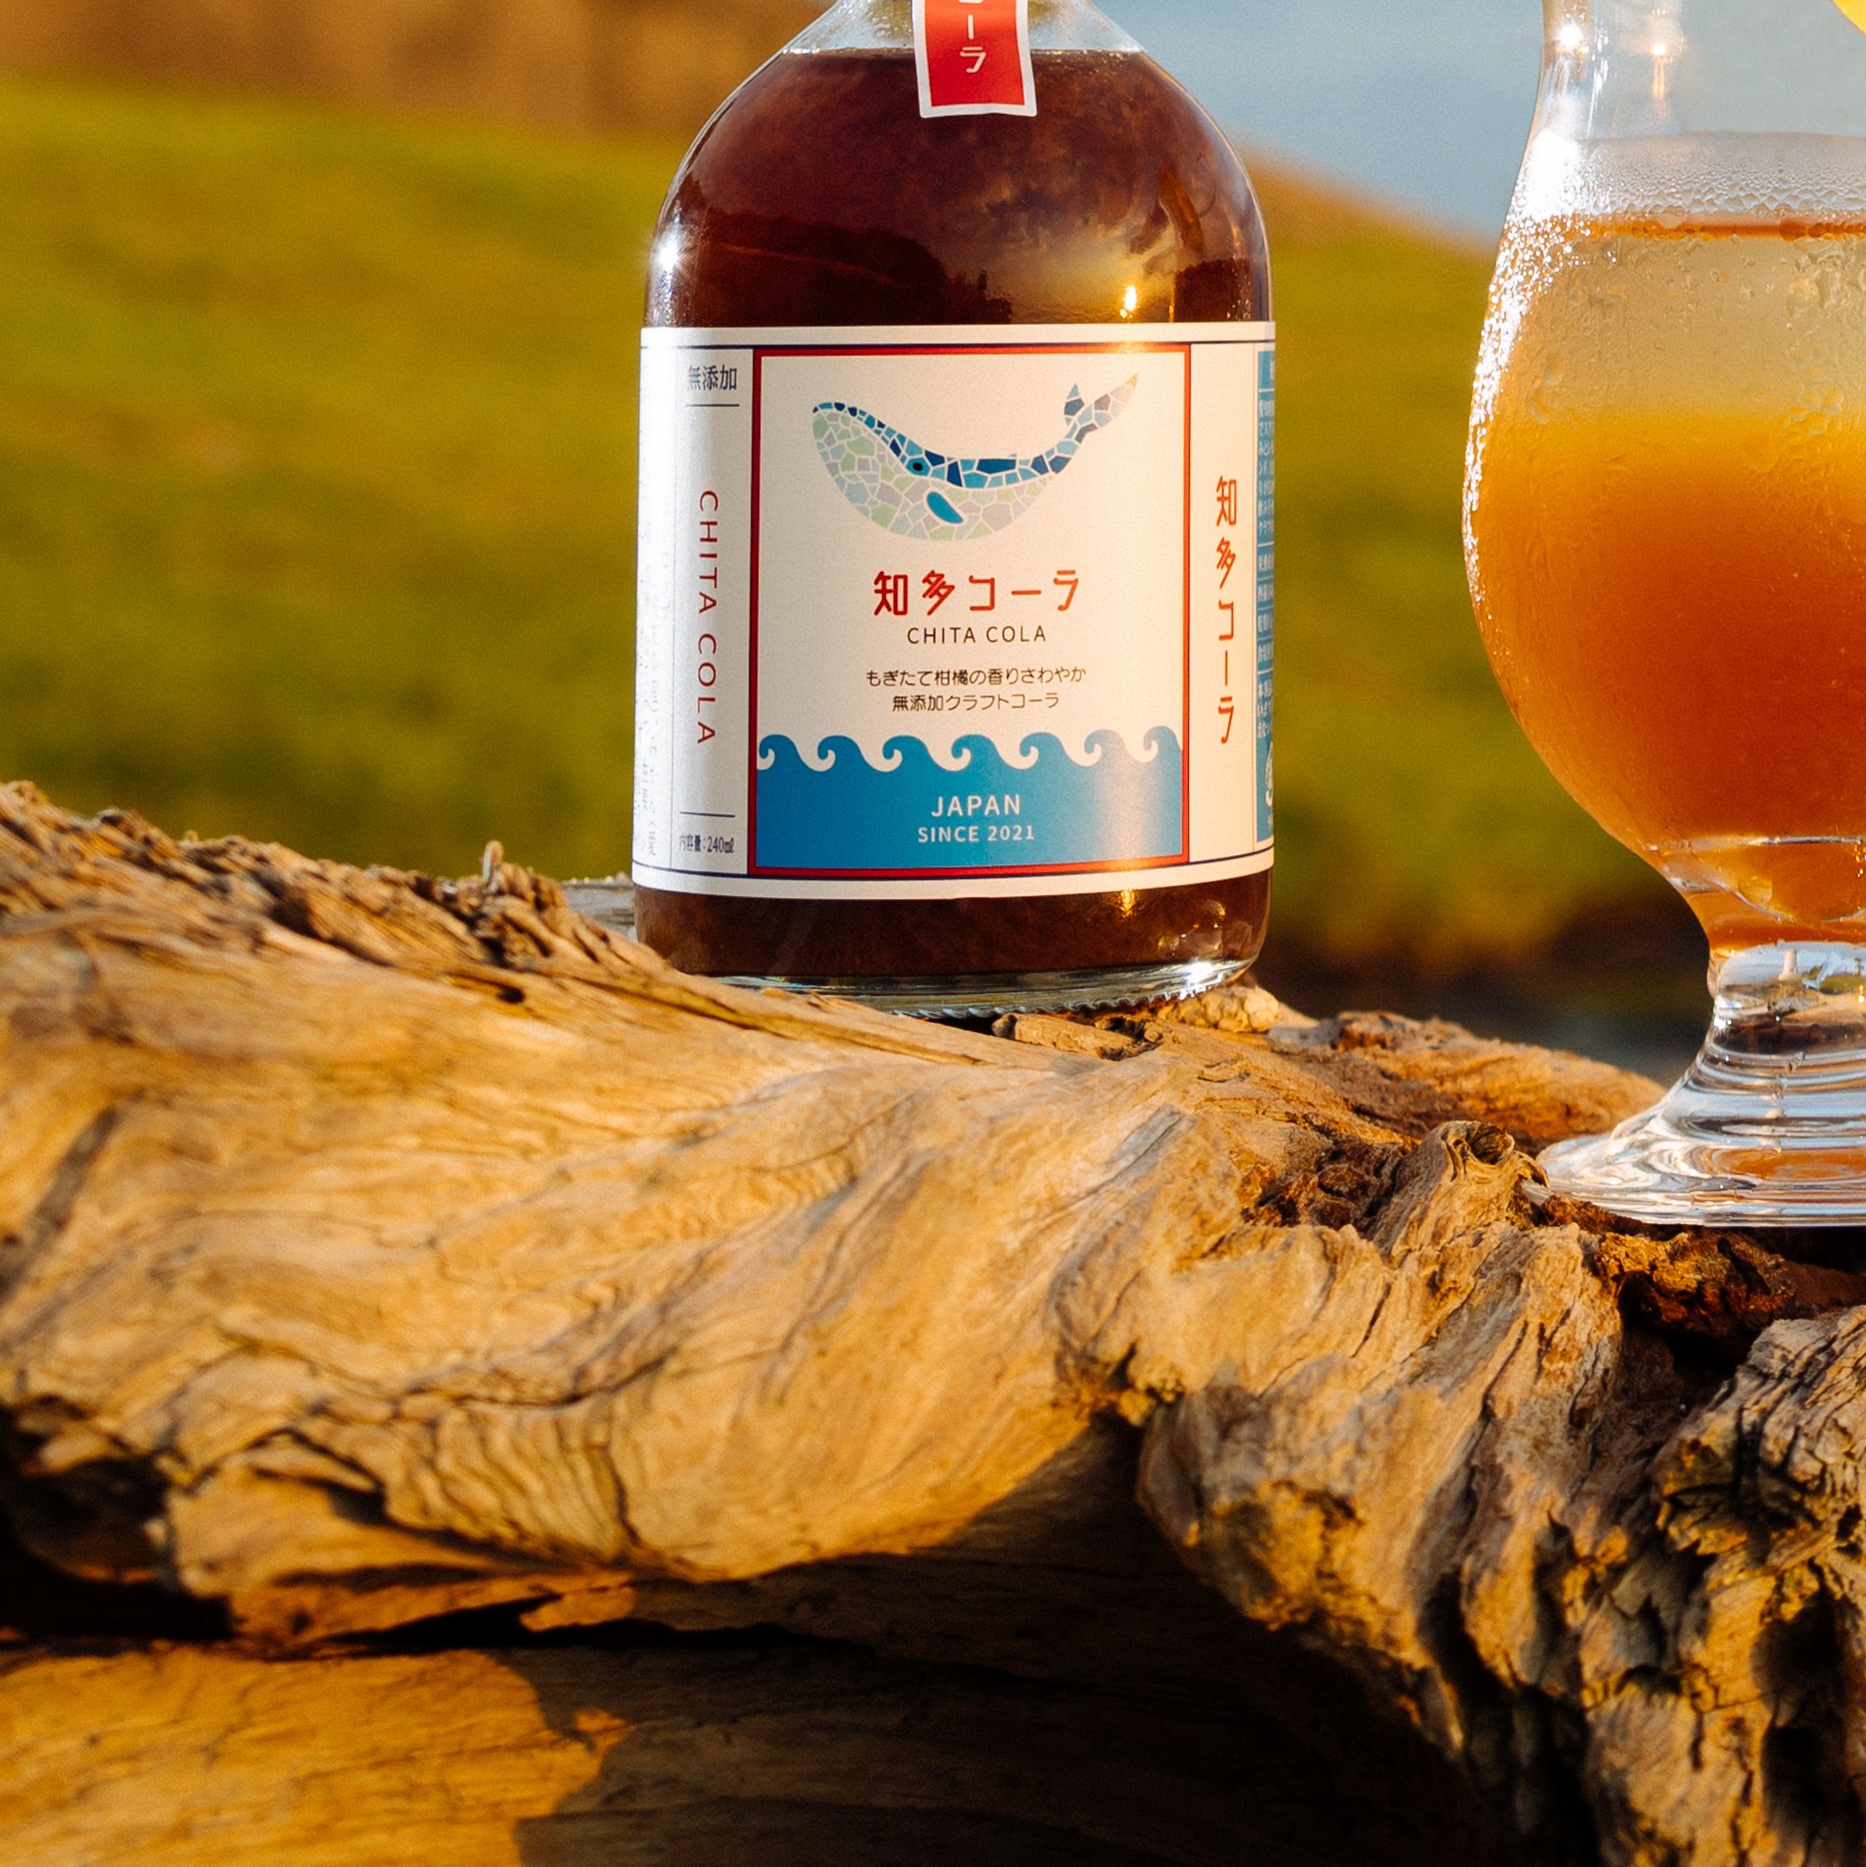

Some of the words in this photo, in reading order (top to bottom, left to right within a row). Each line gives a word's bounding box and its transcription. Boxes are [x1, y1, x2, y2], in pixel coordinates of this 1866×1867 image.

[687, 364, 738, 391] 無添加
[698, 489, 719, 614] CHITA
[873, 569, 1079, 616] 知多コーラ
[1216, 475, 1238, 744] 知多コーラ
[906, 626, 977, 645] CHITA
[985, 624, 1047, 643] COLA
[697, 633, 717, 744] COLA
[866, 666, 1087, 688] もぎたて柑橘の香りさわやか
[891, 691, 1060, 712] 無添加クラフトコーラ
[930, 794, 1021, 817] JAPAN
[917, 825, 980, 843] SINCE
[986, 824, 1035, 842] 2021
